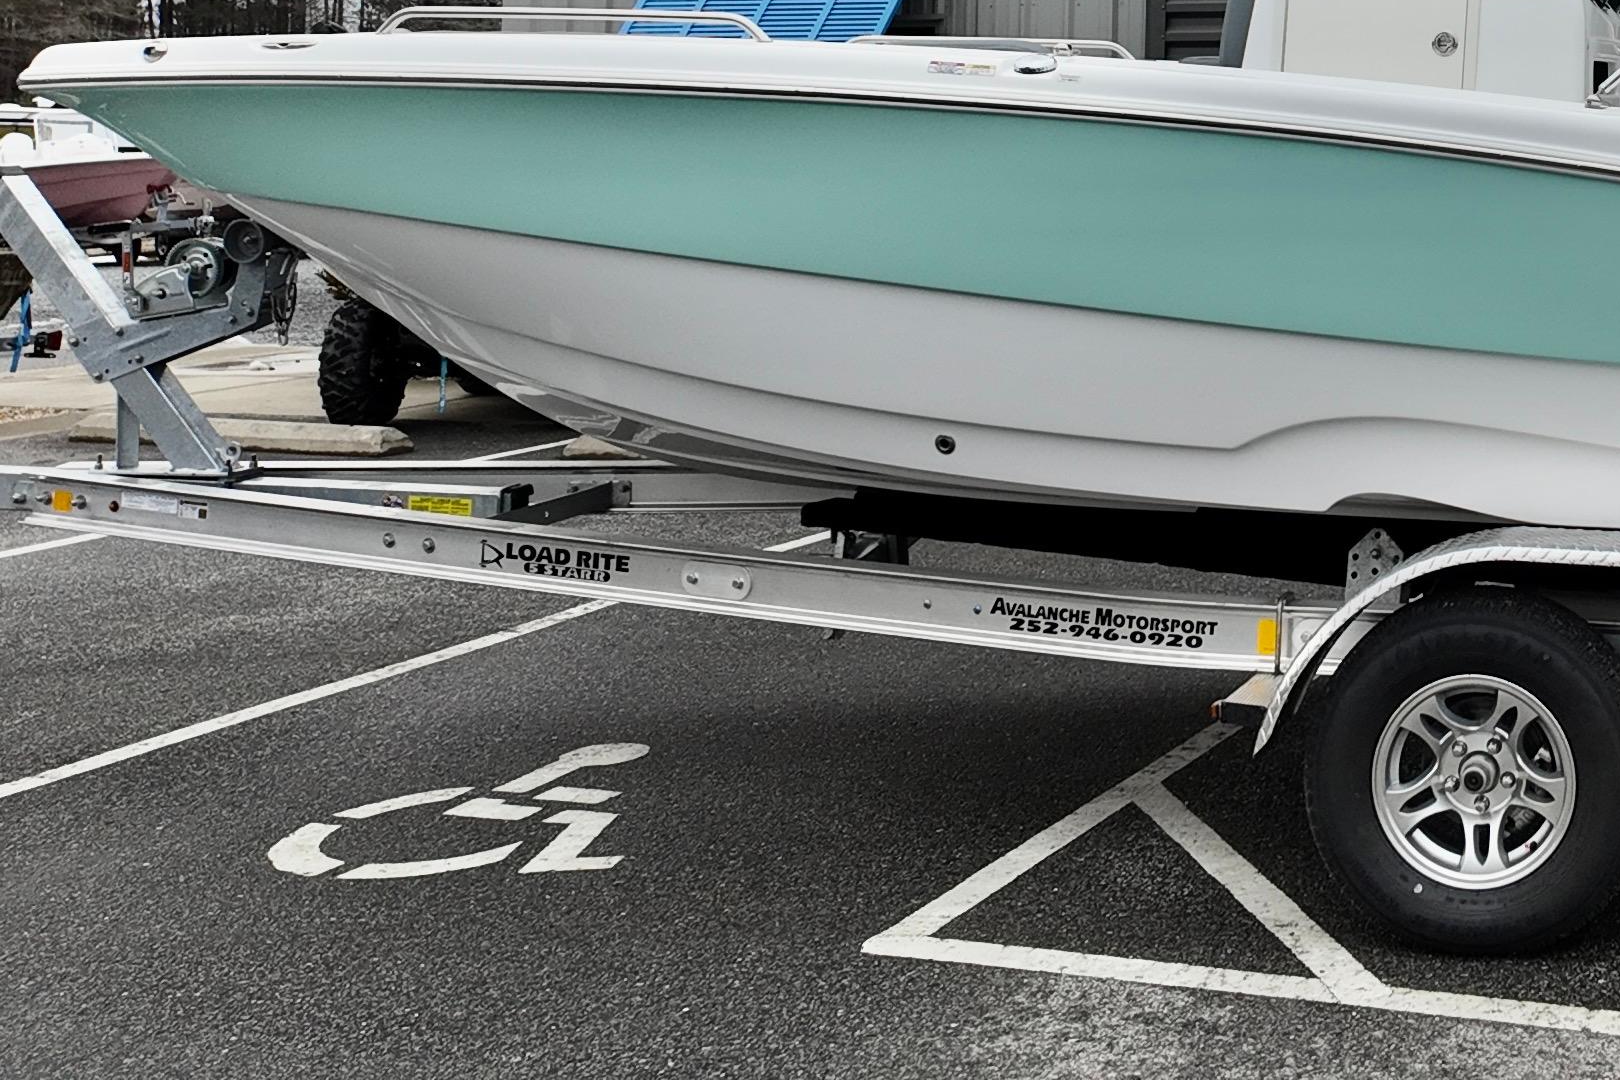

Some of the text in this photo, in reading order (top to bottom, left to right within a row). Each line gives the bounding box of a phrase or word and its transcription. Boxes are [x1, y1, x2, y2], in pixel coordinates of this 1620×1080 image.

[505, 542, 631, 573] LOAD RITE
[990, 597, 1219, 636] AVALANCHE MOTORSPORT
[1009, 617, 1204, 649] 252-946-0920
